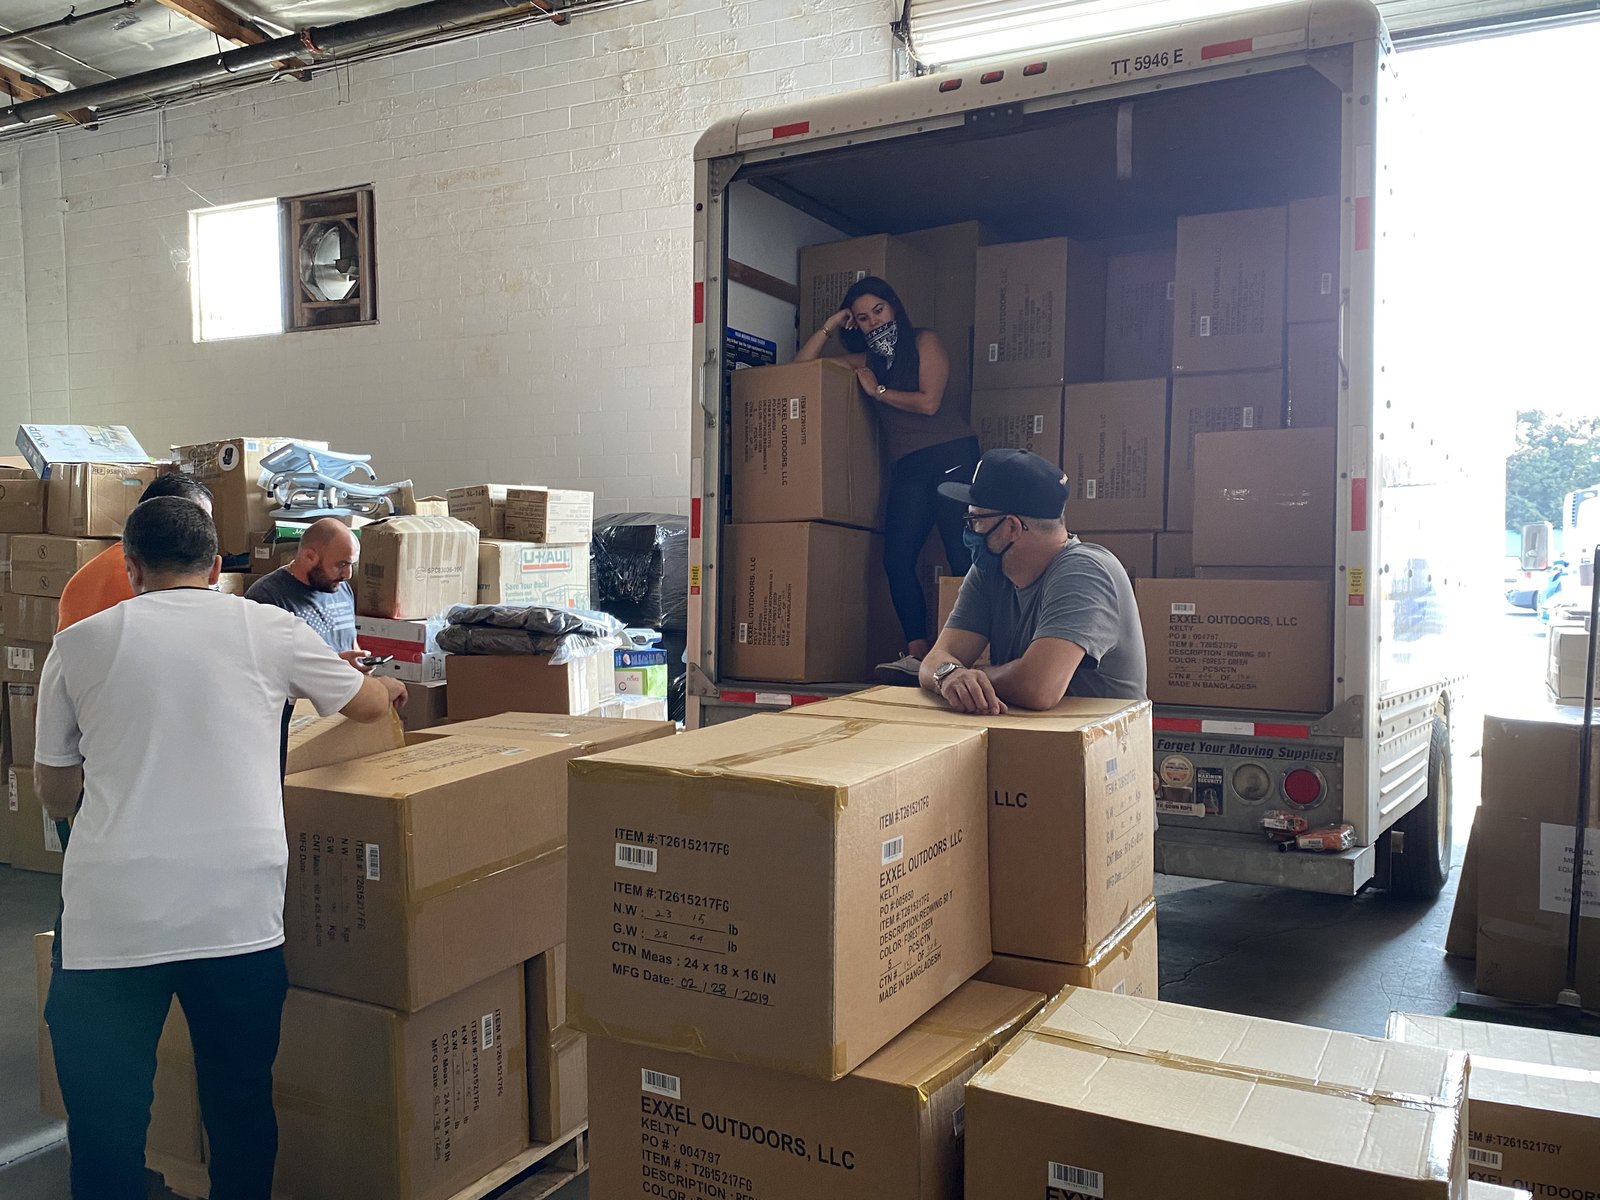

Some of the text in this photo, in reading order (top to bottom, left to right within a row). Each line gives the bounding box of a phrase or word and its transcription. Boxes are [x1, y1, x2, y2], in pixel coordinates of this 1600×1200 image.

[1111, 48, 1184, 75] TT 5946 E
[28, 425, 49, 449] drive
[1169, 614, 1298, 627] EXXEL OUTDOORS, LLC
[1168, 680, 1191, 688] MADE
[1157, 738, 1339, 762] Forget Your Moving Supplies!
[994, 790, 1028, 808] LLC
[879, 811, 894, 830] ITEM
[615, 827, 644, 843] ITEM
[880, 862, 907, 888] EXXEL
[950, 828, 963, 848] LLC
[613, 881, 643, 896] ITEM
[879, 884, 900, 903] KELTY
[613, 902, 637, 916] N.W
[728, 923, 739, 936] lb
[880, 915, 895, 932] ITEM
[613, 922, 638, 936] G.W
[727, 941, 738, 953] lb
[611, 941, 776, 984] CTN Meas 24 x 18 x 16 IN
[612, 963, 639, 978] MFG
[643, 970, 674, 986] Date:
[879, 983, 898, 1004] MADE
[905, 950, 942, 986] BANGLADESH
[879, 972, 893, 989] CTN
[641, 1117, 680, 1137] KELTY
[641, 1096, 855, 1170] EXXEL OUTDOORS, LLC
[1468, 1130, 1483, 1142] EM
[641, 1133, 659, 1148] PO
[680, 1143, 721, 1165] 004797
[642, 1149, 671, 1167] ITEM
[642, 1165, 726, 1200] DESCRIPTION
[642, 1181, 686, 1200] COLOR
